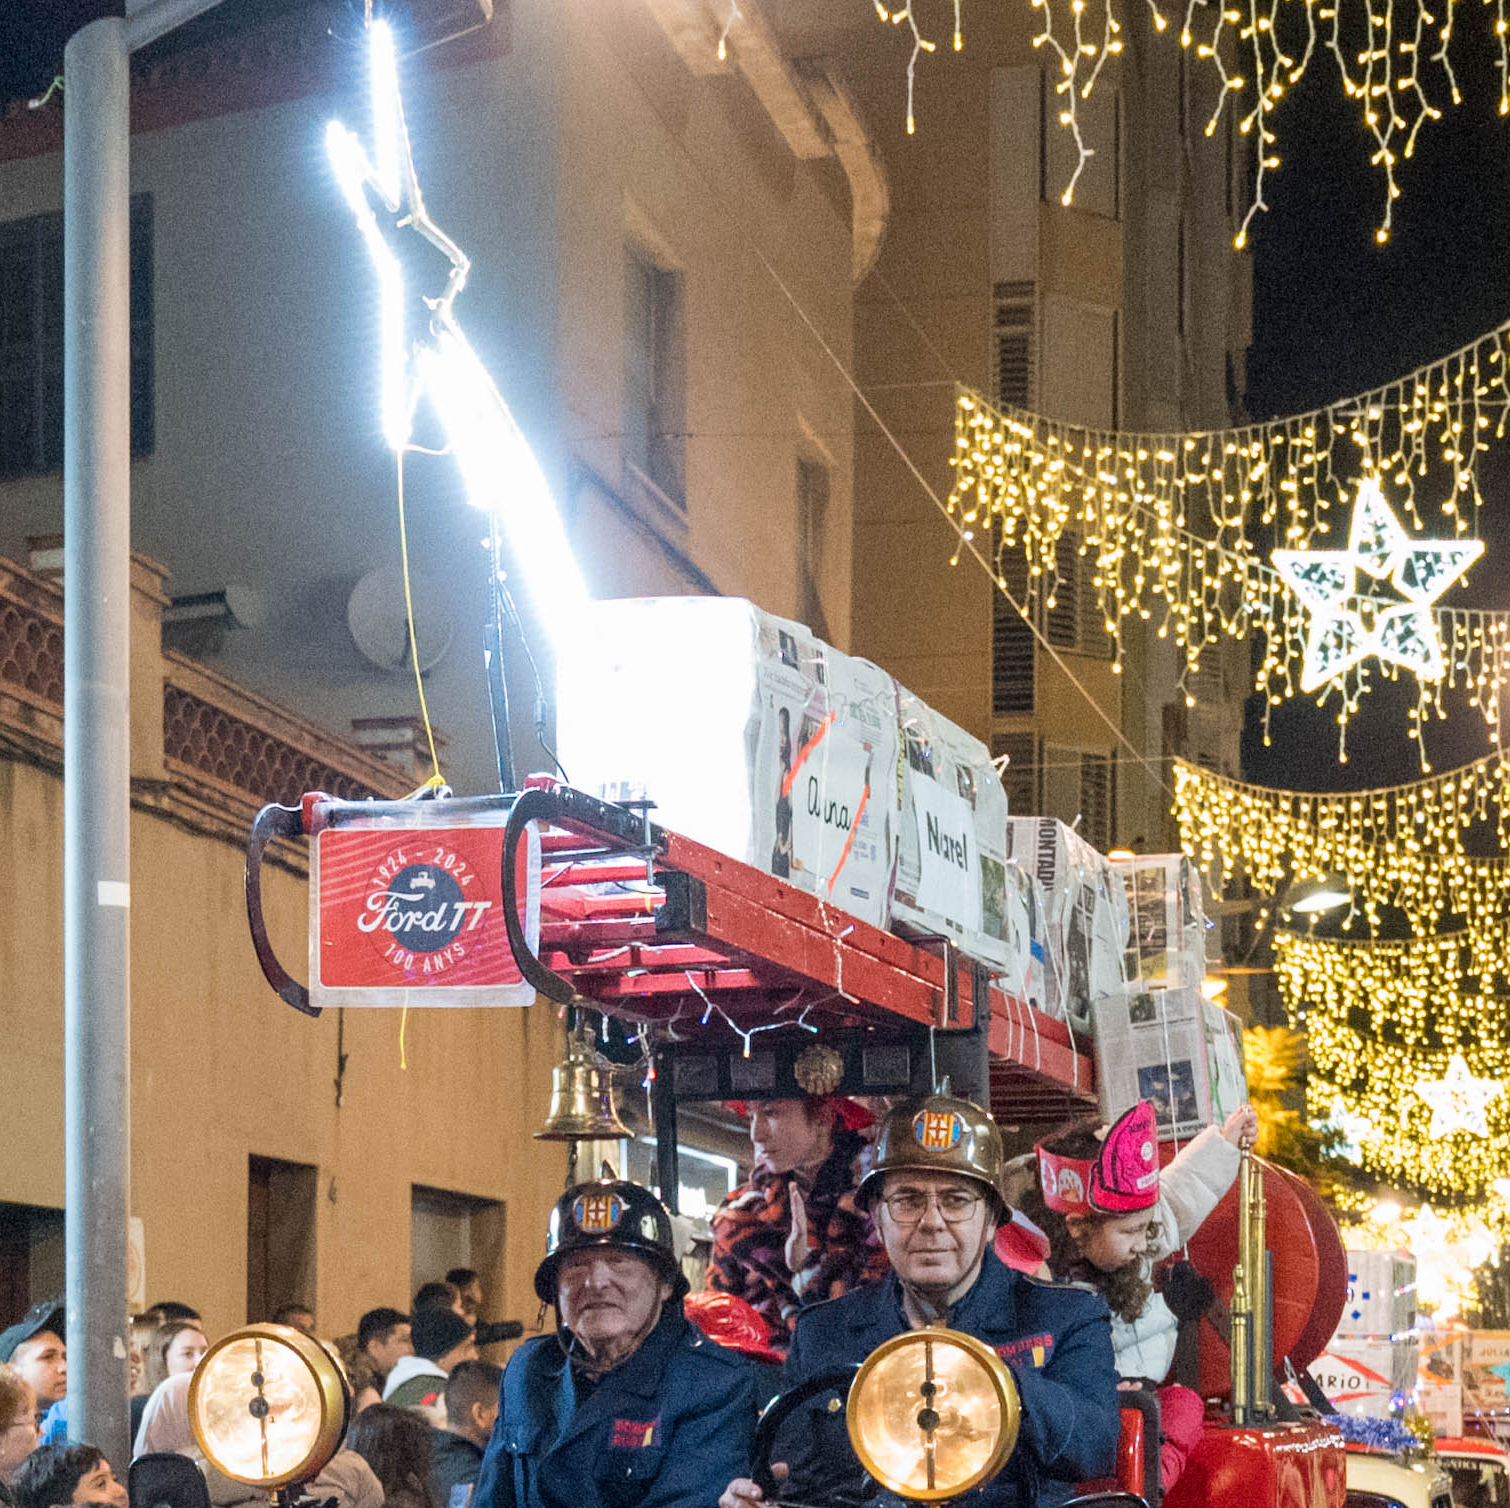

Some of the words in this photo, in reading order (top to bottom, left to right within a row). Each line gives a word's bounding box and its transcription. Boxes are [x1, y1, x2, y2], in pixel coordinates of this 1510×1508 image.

[372, 848, 408, 888] 1924
[433, 848, 475, 887] 2024
[357, 890, 448, 933] Ford
[448, 901, 493, 932] TT
[385, 942, 414, 970] 100
[423, 942, 466, 973] ANYS
[994, 1333, 1054, 1357] OMBERS
